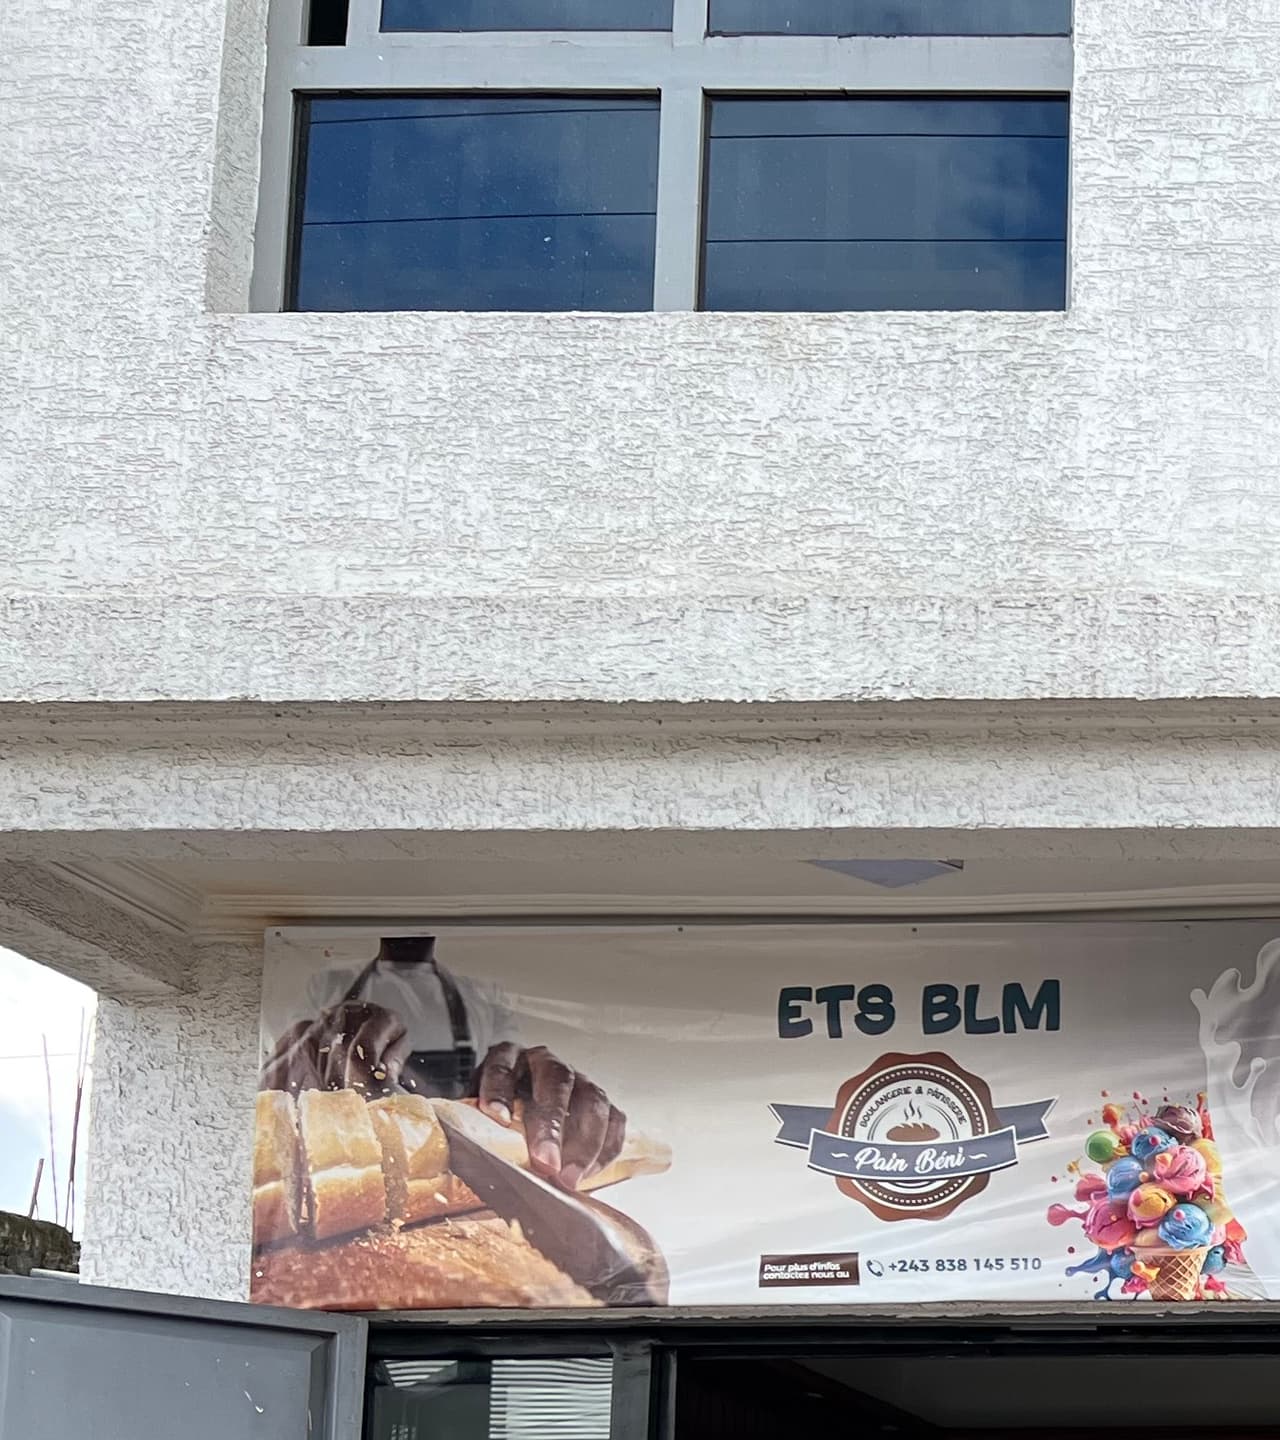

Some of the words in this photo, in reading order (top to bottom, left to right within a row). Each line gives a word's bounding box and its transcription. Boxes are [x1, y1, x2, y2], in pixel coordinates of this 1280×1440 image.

[778, 984, 896, 1039] ETS
[922, 979, 1061, 1035] BLM
[859, 1086, 913, 1128] BOULANGERIE
[914, 1085, 924, 1095] &
[854, 1147, 909, 1171] Pain
[913, 1146, 966, 1174] Béni
[763, 1271, 810, 1280] contactez
[811, 1270, 835, 1279] nous
[836, 1270, 850, 1279] au
[764, 1264, 787, 1273] Pour
[788, 1263, 809, 1273] plus
[809, 1261, 841, 1271] d'infos
[888, 1259, 930, 1272] +243
[935, 1258, 968, 1272] 838
[973, 1257, 1005, 1271] 145
[1010, 1257, 1042, 1271] 510
